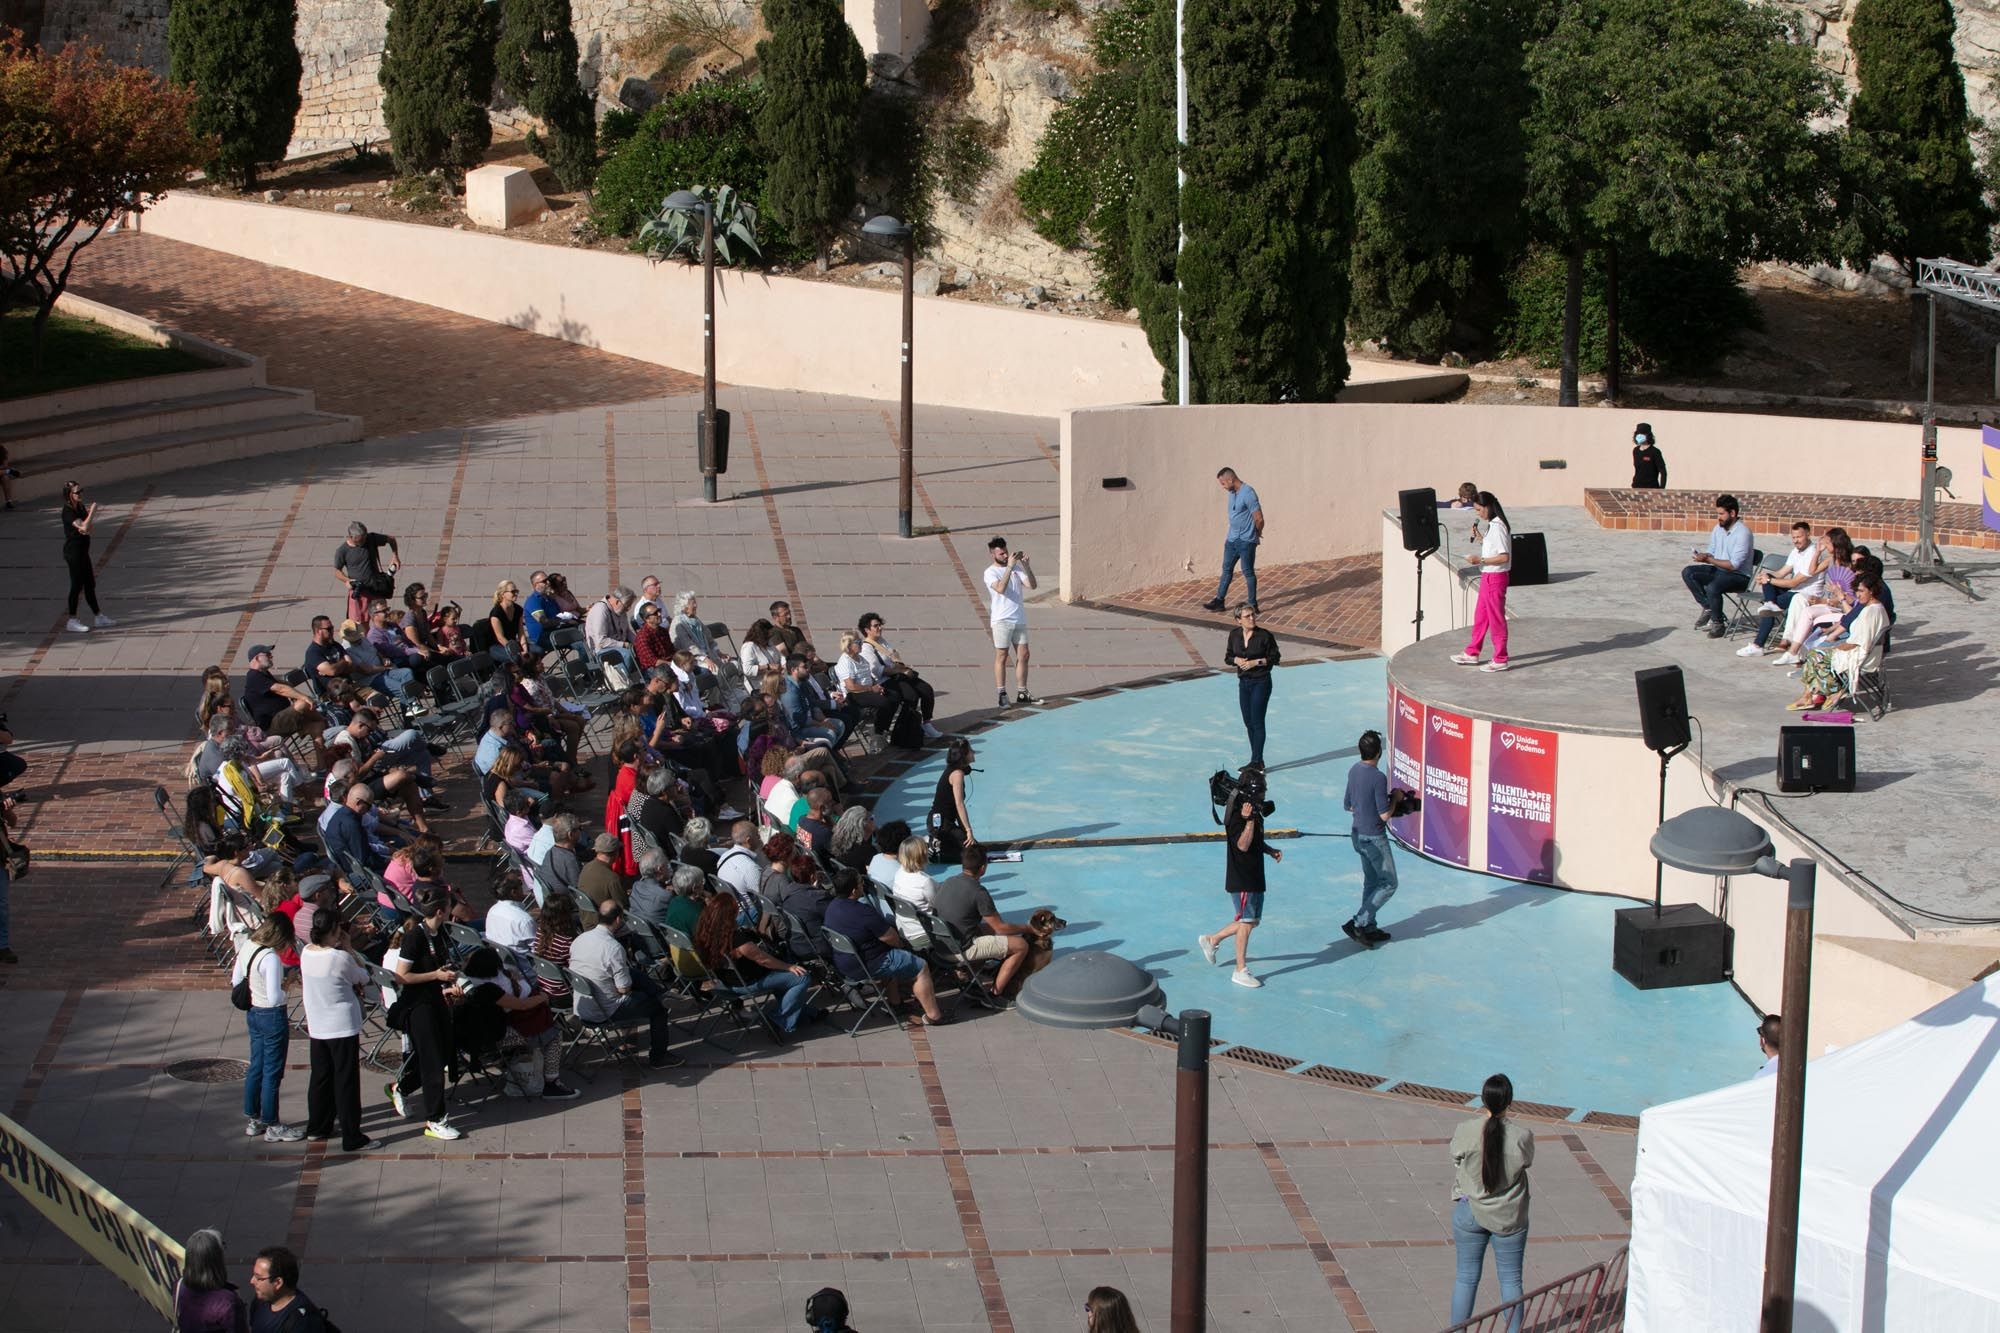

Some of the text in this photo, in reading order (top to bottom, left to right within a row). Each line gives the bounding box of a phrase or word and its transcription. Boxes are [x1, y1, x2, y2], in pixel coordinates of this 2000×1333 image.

[1443, 719, 1458, 729] Unidas
[1443, 728, 1464, 738] Podemos
[1517, 735, 1538, 744] Unidas
[1516, 743, 1545, 754] Podemos
[1427, 765, 1468, 786] VALENTIA PER
[1426, 775, 1468, 796] TRANSFORMAR
[1492, 783, 1551, 802] VALENTIA PER
[1442, 792, 1468, 806] EL FUTUR
[1492, 795, 1551, 812] TRANSFORMAR
[1516, 807, 1551, 822] EL FUTUR
